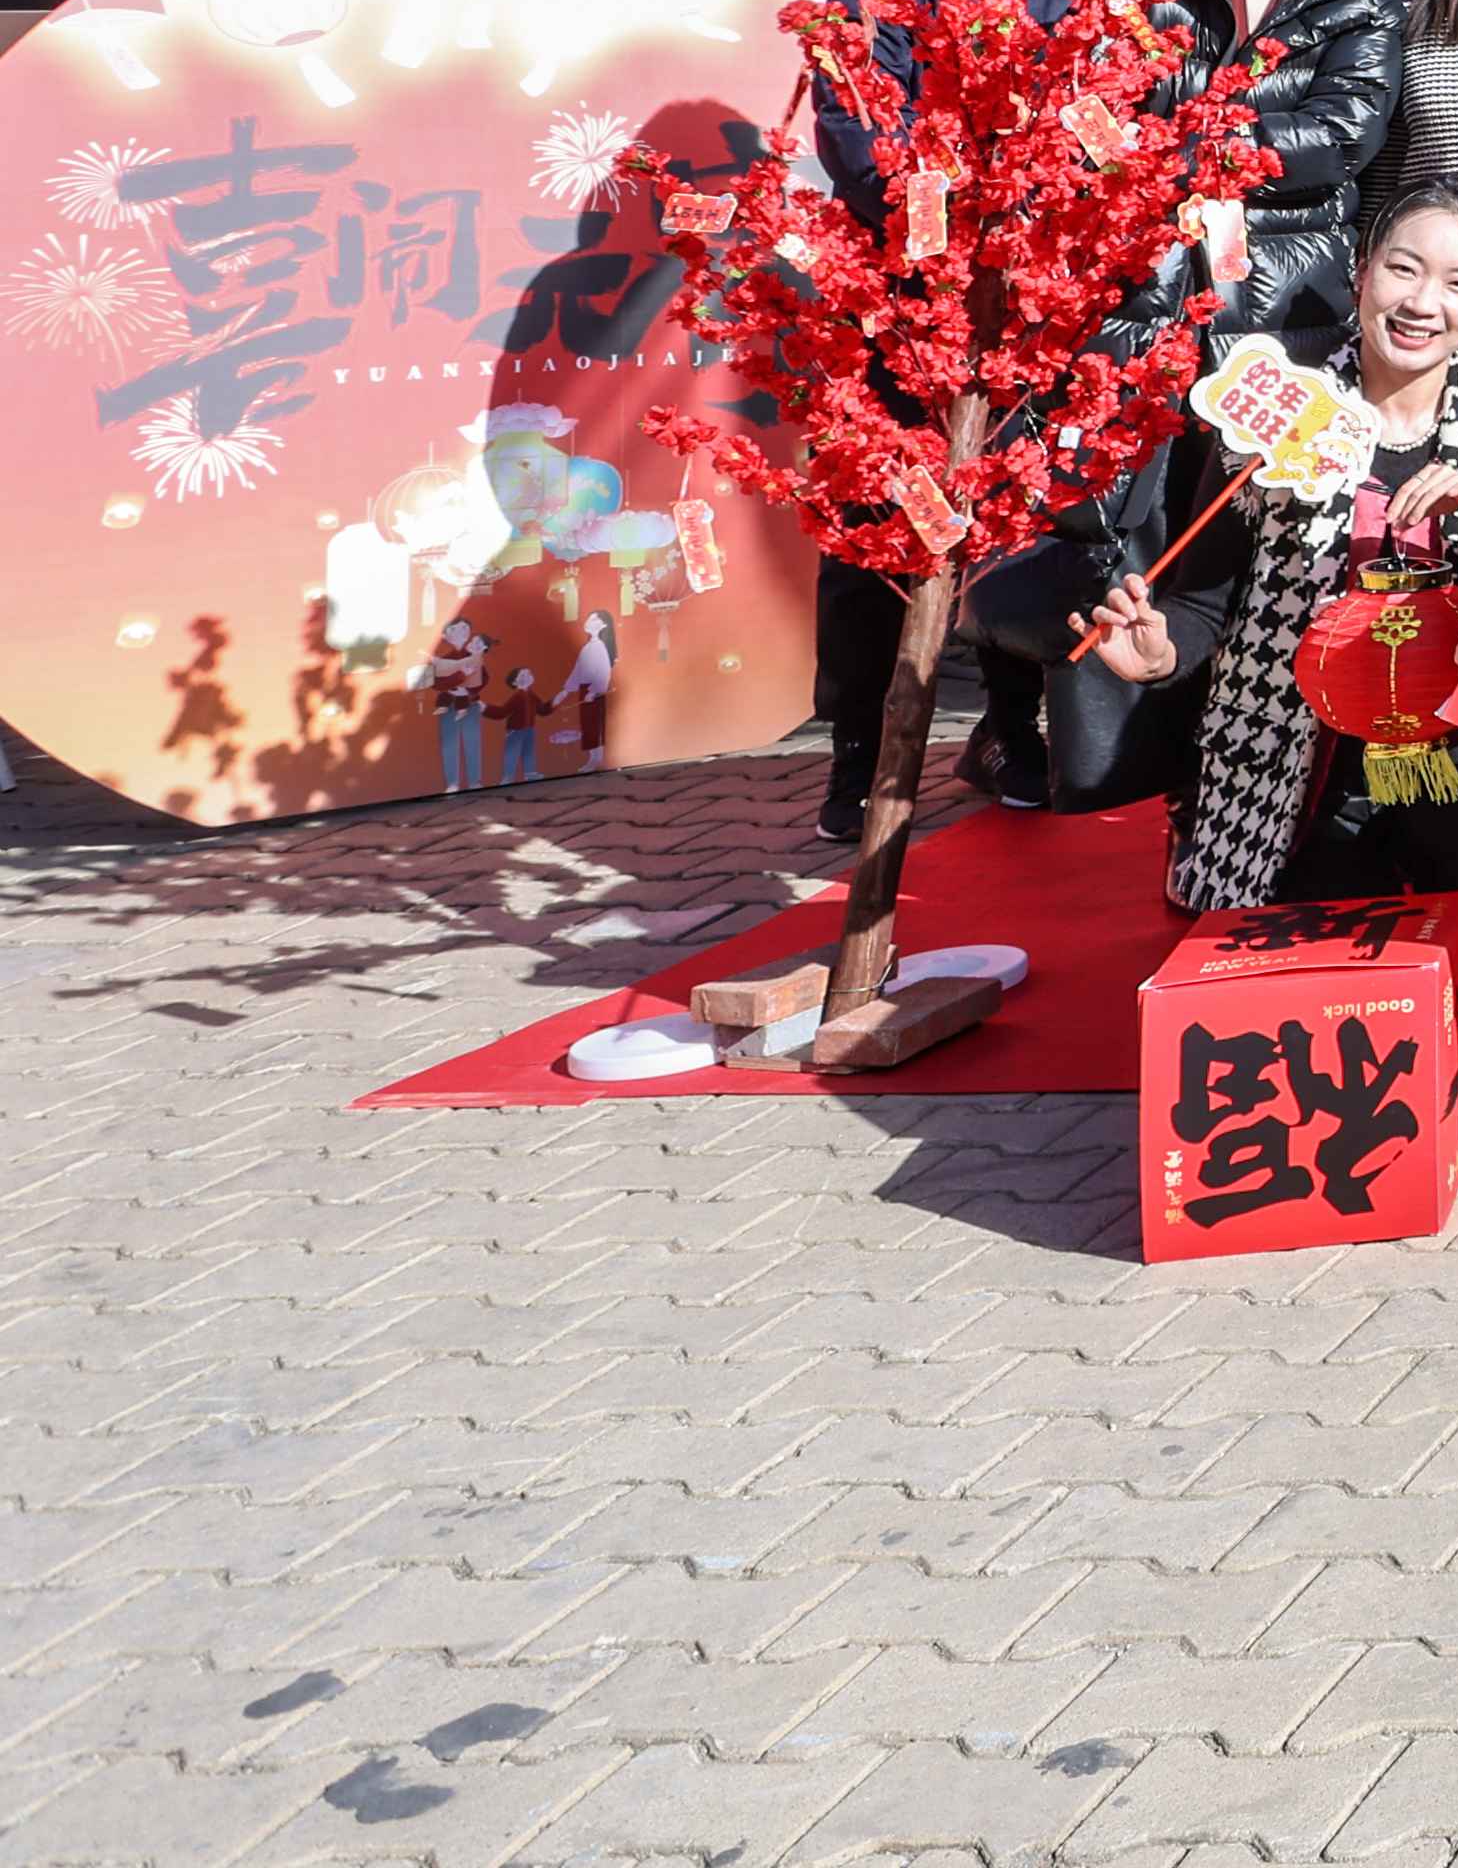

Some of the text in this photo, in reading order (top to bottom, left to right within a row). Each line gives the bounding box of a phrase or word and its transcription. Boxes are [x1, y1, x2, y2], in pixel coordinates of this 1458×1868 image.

[1322, 998, 1415, 1019] Good luck
[1170, 1015, 1420, 1230] 福
